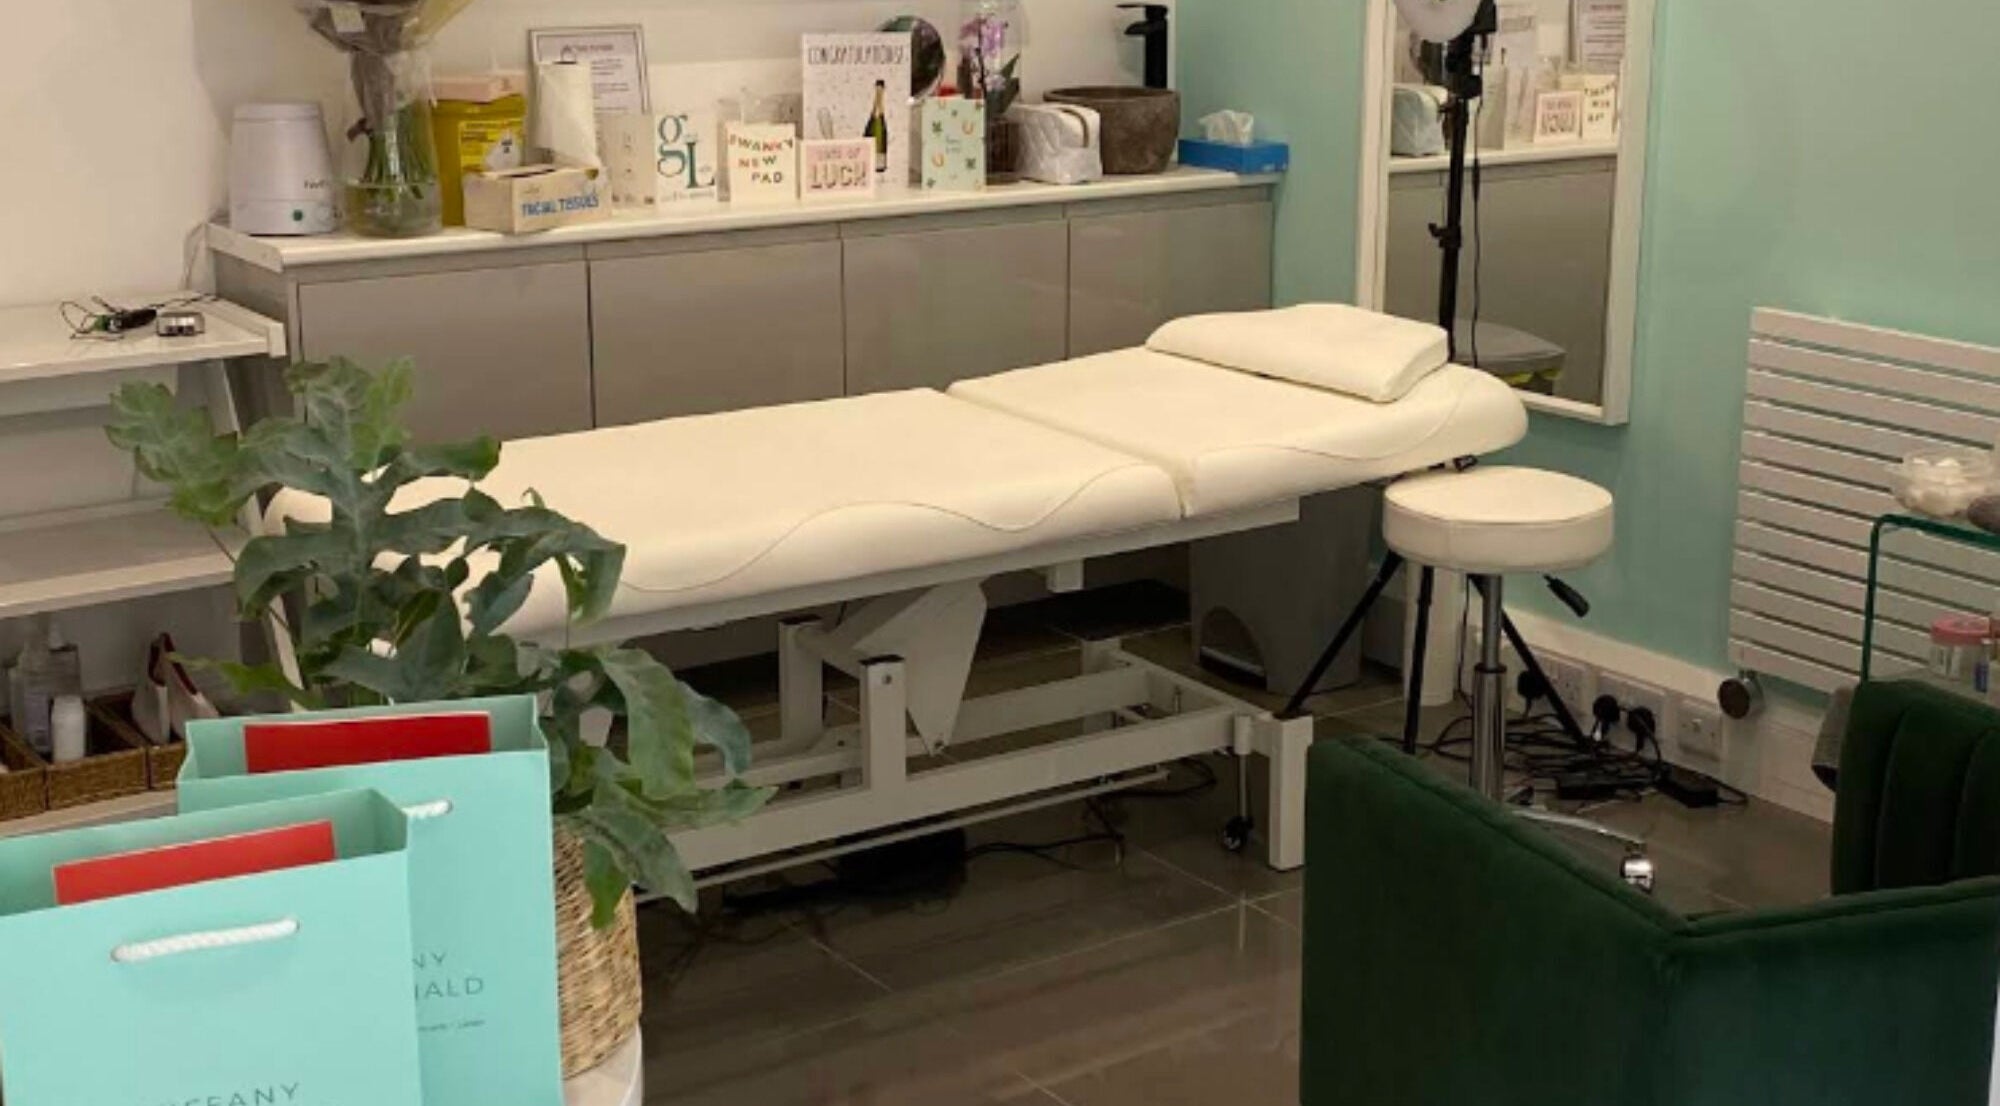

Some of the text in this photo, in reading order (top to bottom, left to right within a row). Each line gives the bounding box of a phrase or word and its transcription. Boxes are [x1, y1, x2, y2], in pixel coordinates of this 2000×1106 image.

[738, 155, 777, 168] NEW
[751, 171, 783, 184] PAD
[811, 162, 867, 189] LUCK
[412, 951, 447, 970] NY
